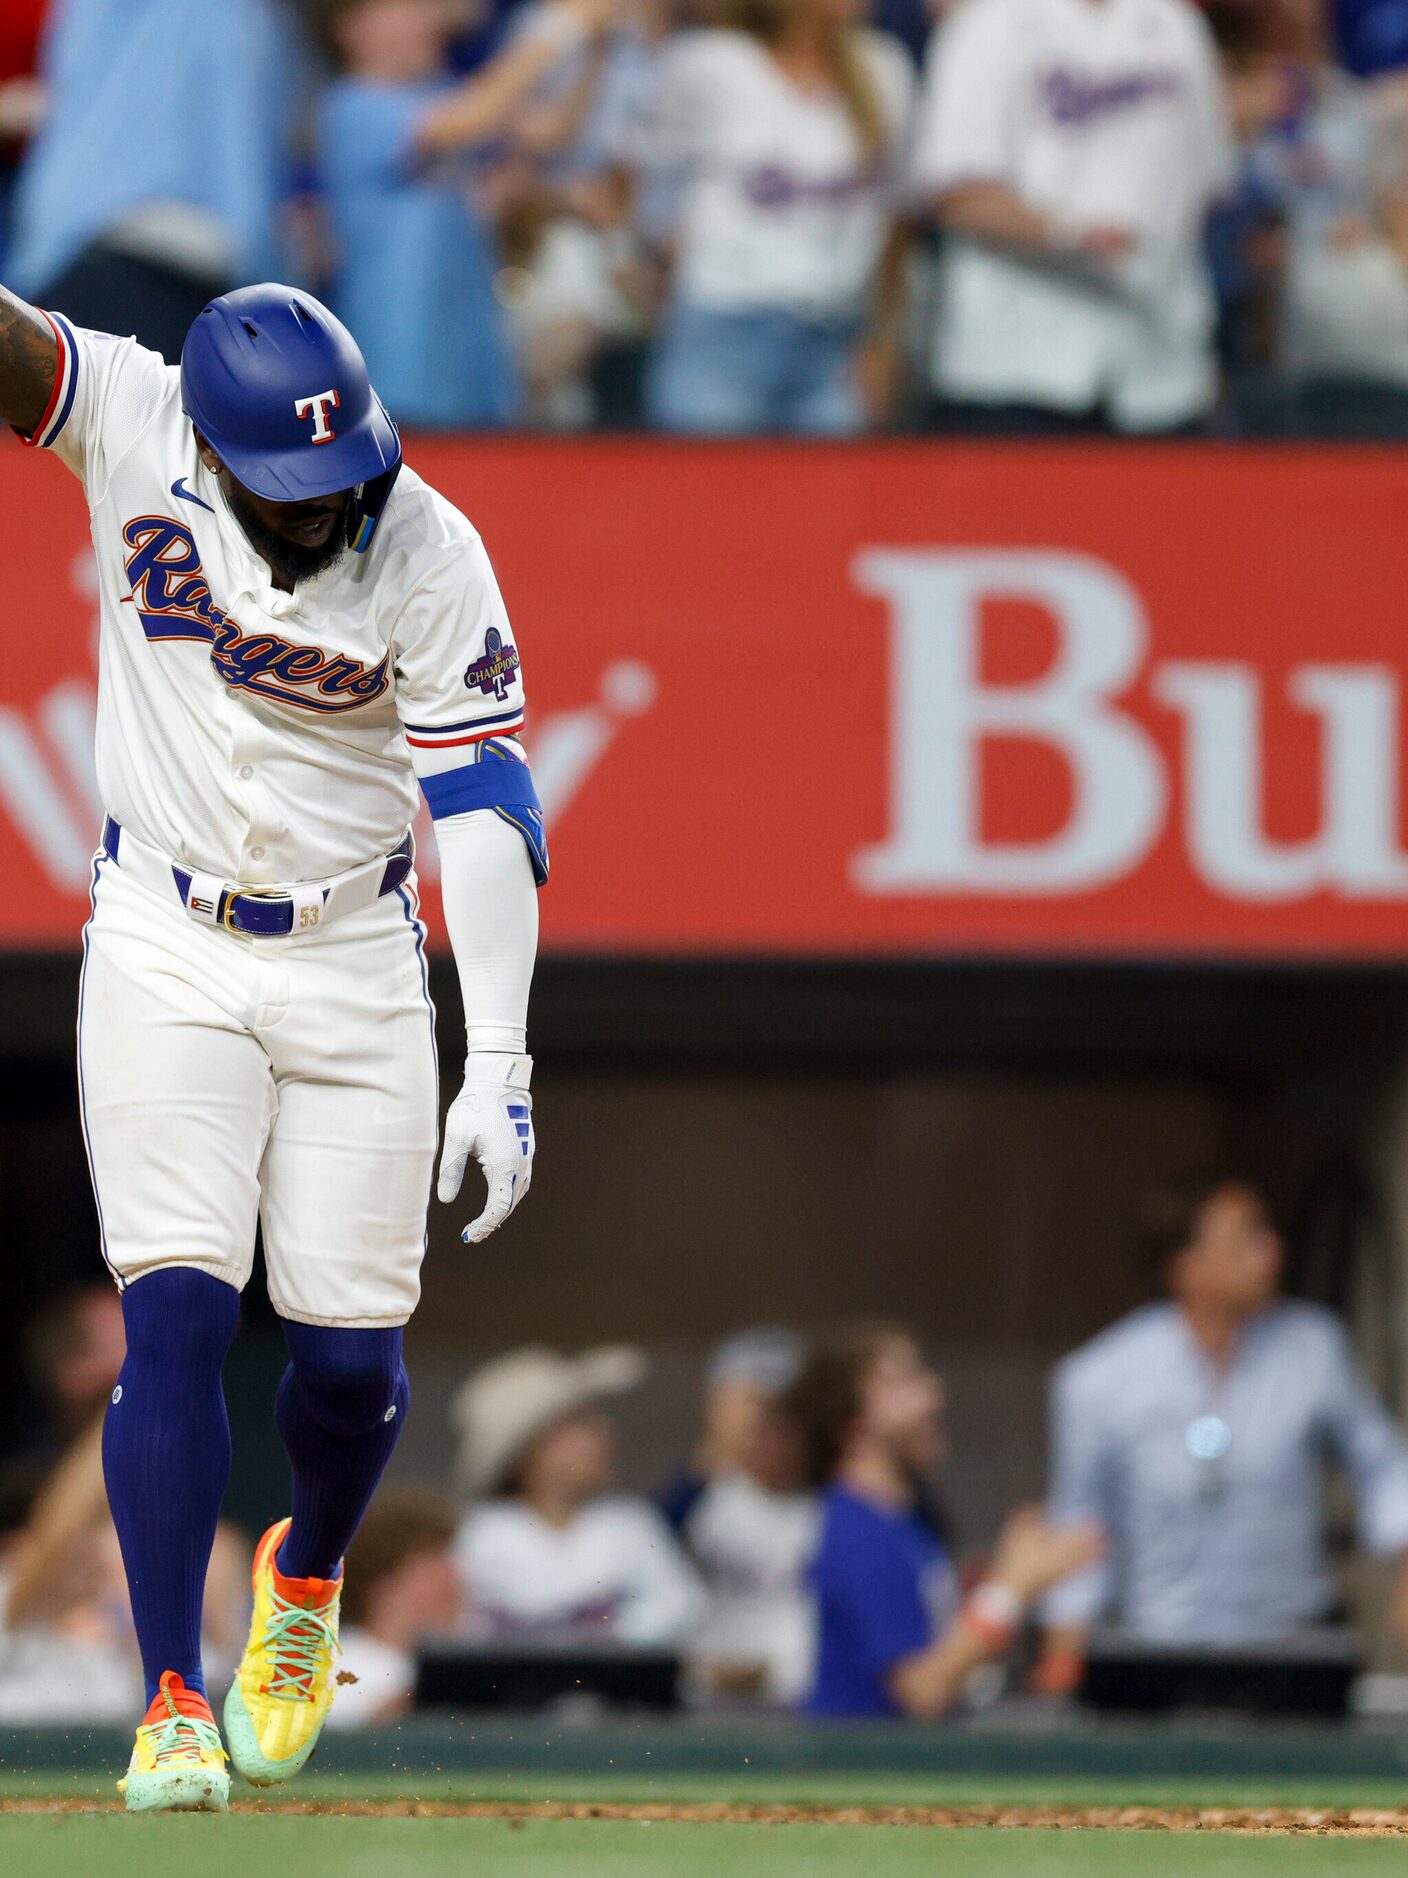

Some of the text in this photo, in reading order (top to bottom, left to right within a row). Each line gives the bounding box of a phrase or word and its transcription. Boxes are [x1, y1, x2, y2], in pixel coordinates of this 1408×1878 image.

[294, 389, 340, 445] T
[122, 514, 390, 713] Rangers
[467, 653, 520, 685] CHAMPIONS
[492, 673, 505, 697] T
[846, 544, 1408, 905] Bu
[299, 904, 319, 928] 53
